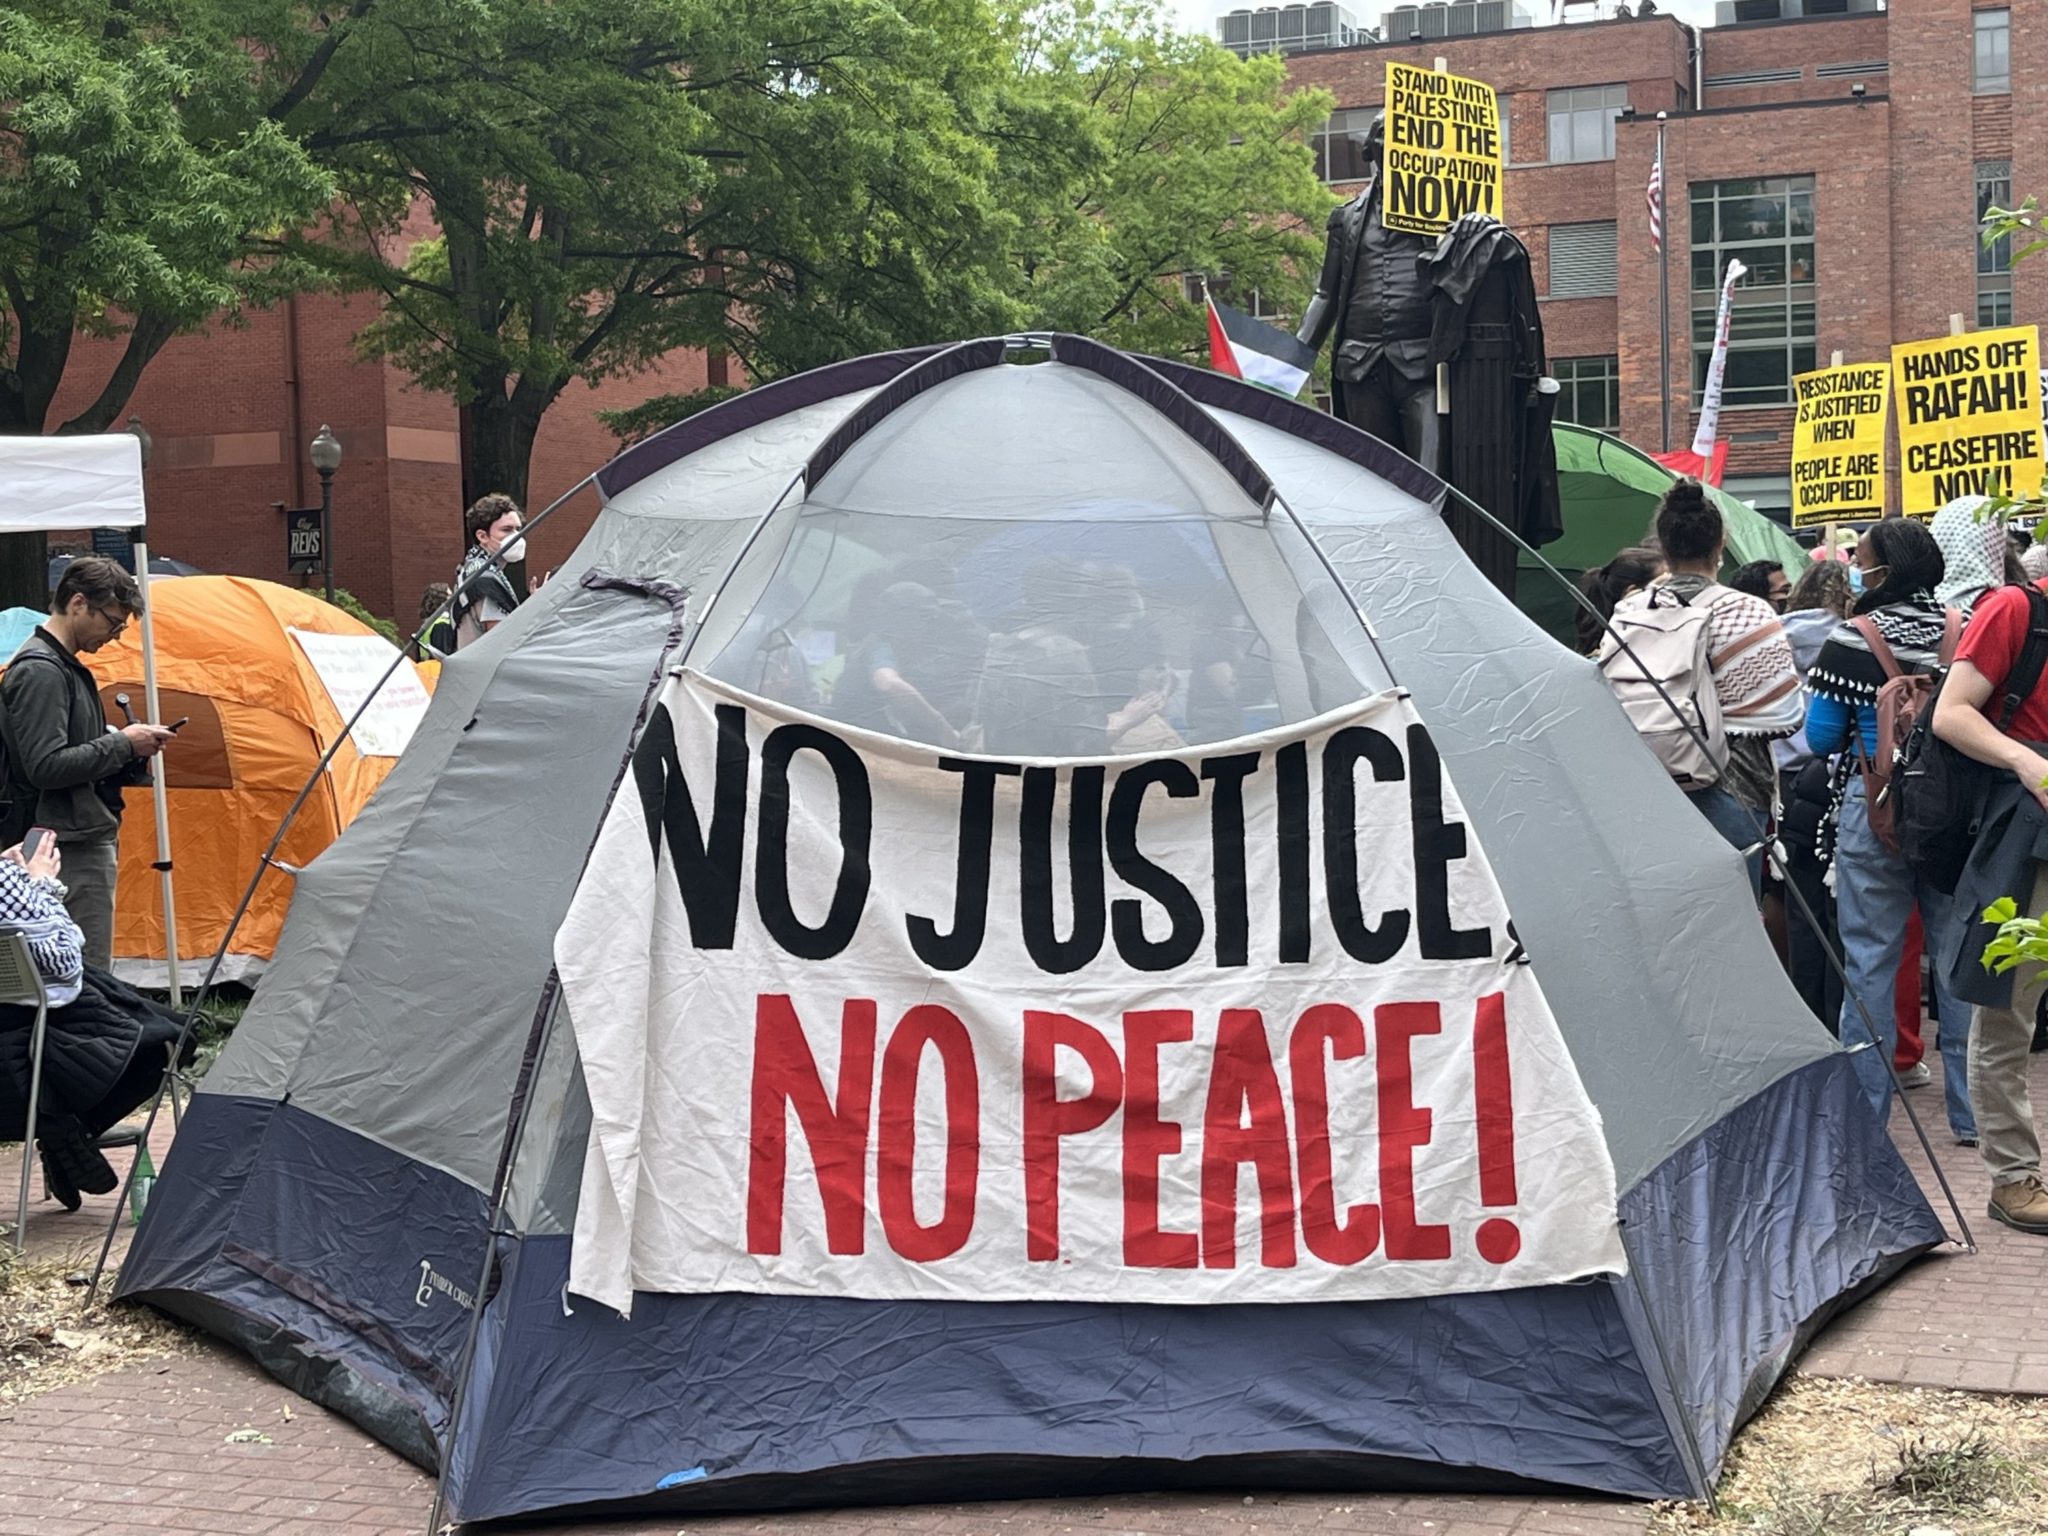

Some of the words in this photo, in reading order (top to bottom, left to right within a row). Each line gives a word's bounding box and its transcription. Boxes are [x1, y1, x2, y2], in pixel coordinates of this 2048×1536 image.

[1392, 67, 1448, 95] STAND
[1451, 79, 1492, 107] WITH
[1392, 89, 1495, 129] PALESTINE!
[1392, 113, 1444, 150] END
[1452, 122, 1498, 158] THE
[1389, 149, 1497, 184] OCCUPATION
[1390, 170, 1494, 221] NOW!
[1902, 345, 1980, 382] HANDS
[1986, 339, 2028, 369] OFF
[1798, 370, 1884, 401] RESISTANCE
[1906, 370, 2028, 425] RAFAH!
[1799, 402, 1810, 424] IS
[1811, 393, 1882, 421] JUSTIFIED
[1813, 419, 1856, 444] WHEN
[1907, 429, 2038, 474] CEASEFIRE
[1794, 455, 1842, 484] PEOPLE
[1845, 453, 1879, 476] ARE
[1933, 464, 2014, 507] NOW!
[1800, 478, 1873, 507] OCCUPIED!
[291, 531, 321, 554] REVS
[632, 700, 872, 961] NO
[746, 993, 981, 1263] NO
[1023, 991, 1521, 1269] PEACE!
